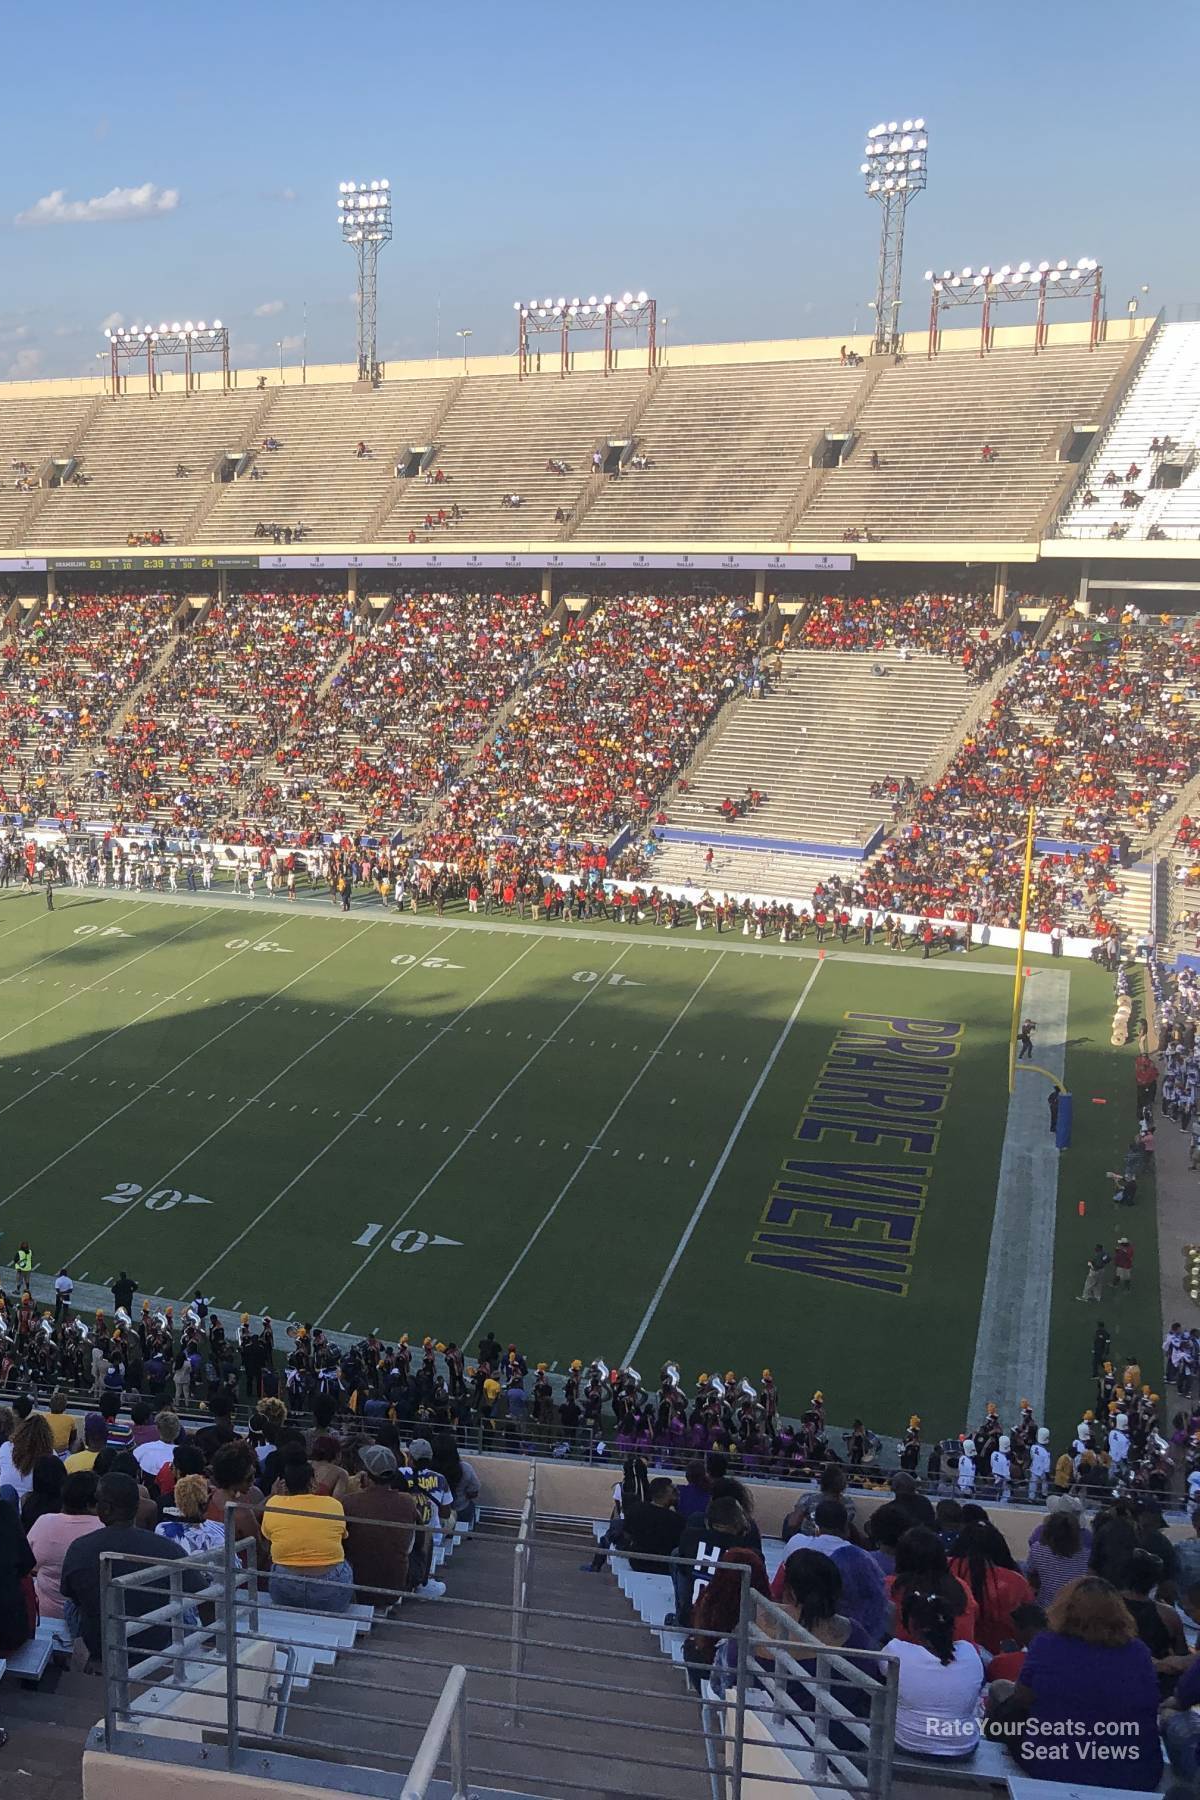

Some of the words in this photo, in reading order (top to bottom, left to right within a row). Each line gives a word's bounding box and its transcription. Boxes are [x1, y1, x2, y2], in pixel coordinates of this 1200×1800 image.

[90, 560, 102, 569] 23
[144, 560, 164, 568] 2:39
[201, 559, 213, 568] 24
[73, 925, 124, 936] 40
[224, 939, 280, 952] 30
[390, 954, 449, 968] 20
[571, 971, 625, 986] 10
[793, 1011, 966, 1155] PRAIRIE
[101, 1183, 182, 1211] 20
[745, 1159, 933, 1296] VIEW
[352, 1223, 429, 1253] 10
